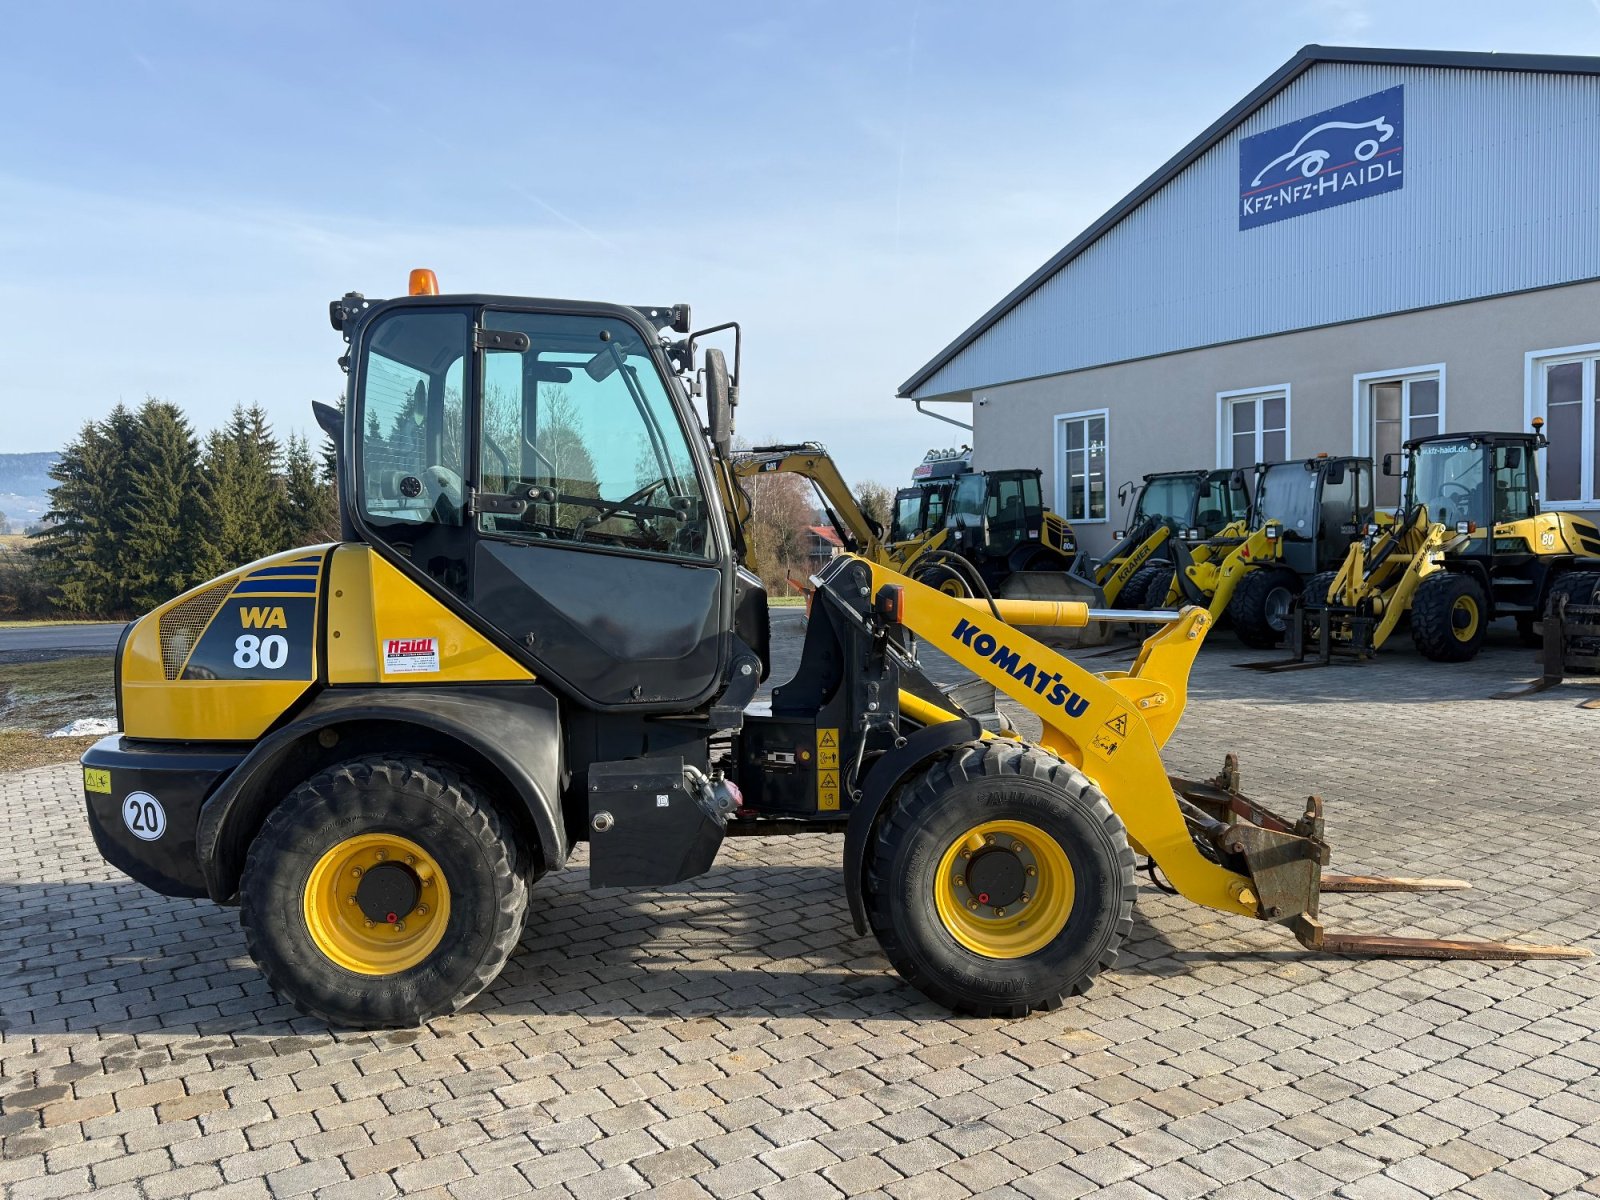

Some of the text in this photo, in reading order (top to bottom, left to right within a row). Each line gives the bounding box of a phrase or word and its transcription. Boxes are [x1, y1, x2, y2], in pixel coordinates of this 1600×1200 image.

[765, 461, 777, 471] CAT
[1541, 533, 1554, 546] 80
[1117, 545, 1151, 582] KRAMER
[240, 606, 288, 629] WA
[233, 634, 289, 669] 80
[387, 638, 434, 654] Haidl
[951, 617, 1090, 718] KOMATSU
[129, 800, 159, 832] 20
